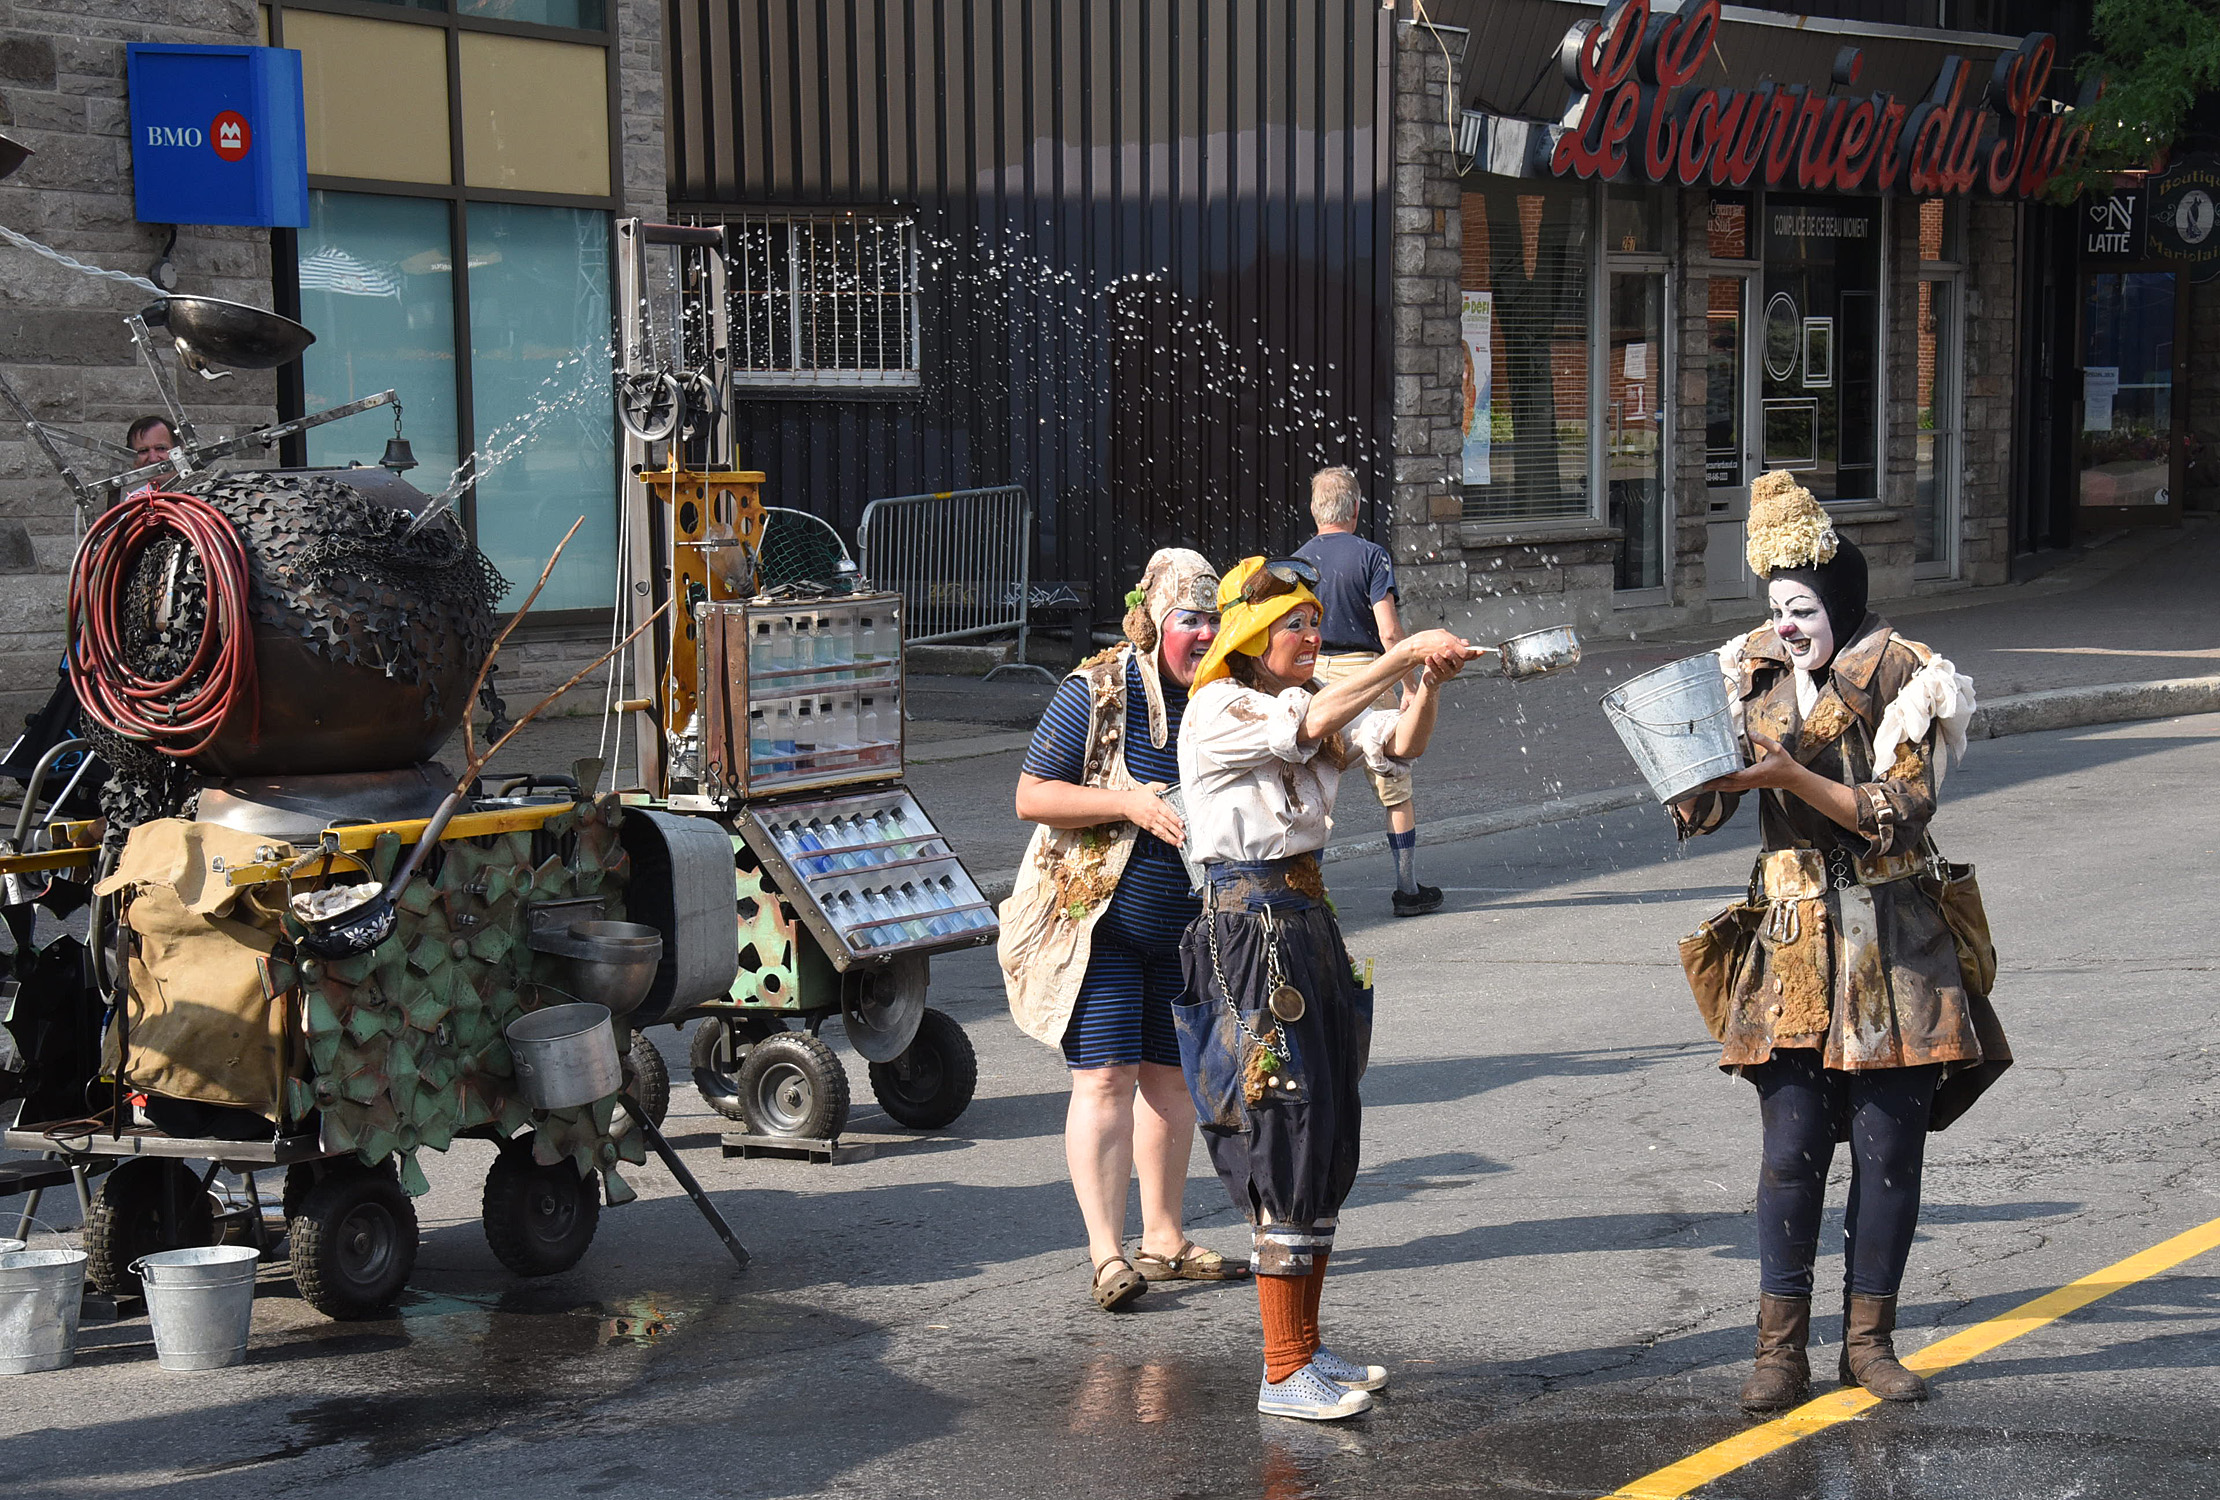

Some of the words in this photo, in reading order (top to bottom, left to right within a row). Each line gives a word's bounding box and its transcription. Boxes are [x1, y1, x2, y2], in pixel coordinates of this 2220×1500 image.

[1551, 0, 1651, 180] Le
[1644, 0, 1906, 188] Courrier
[1909, 56, 1987, 195] du
[147, 126, 202, 148] BMO
[1774, 214, 1806, 236] COMPLICE
[1806, 215, 1815, 236] DE
[1816, 215, 1825, 237] CE
[1825, 216, 1842, 237] BEAU
[1842, 217, 1869, 238] MOMENT
